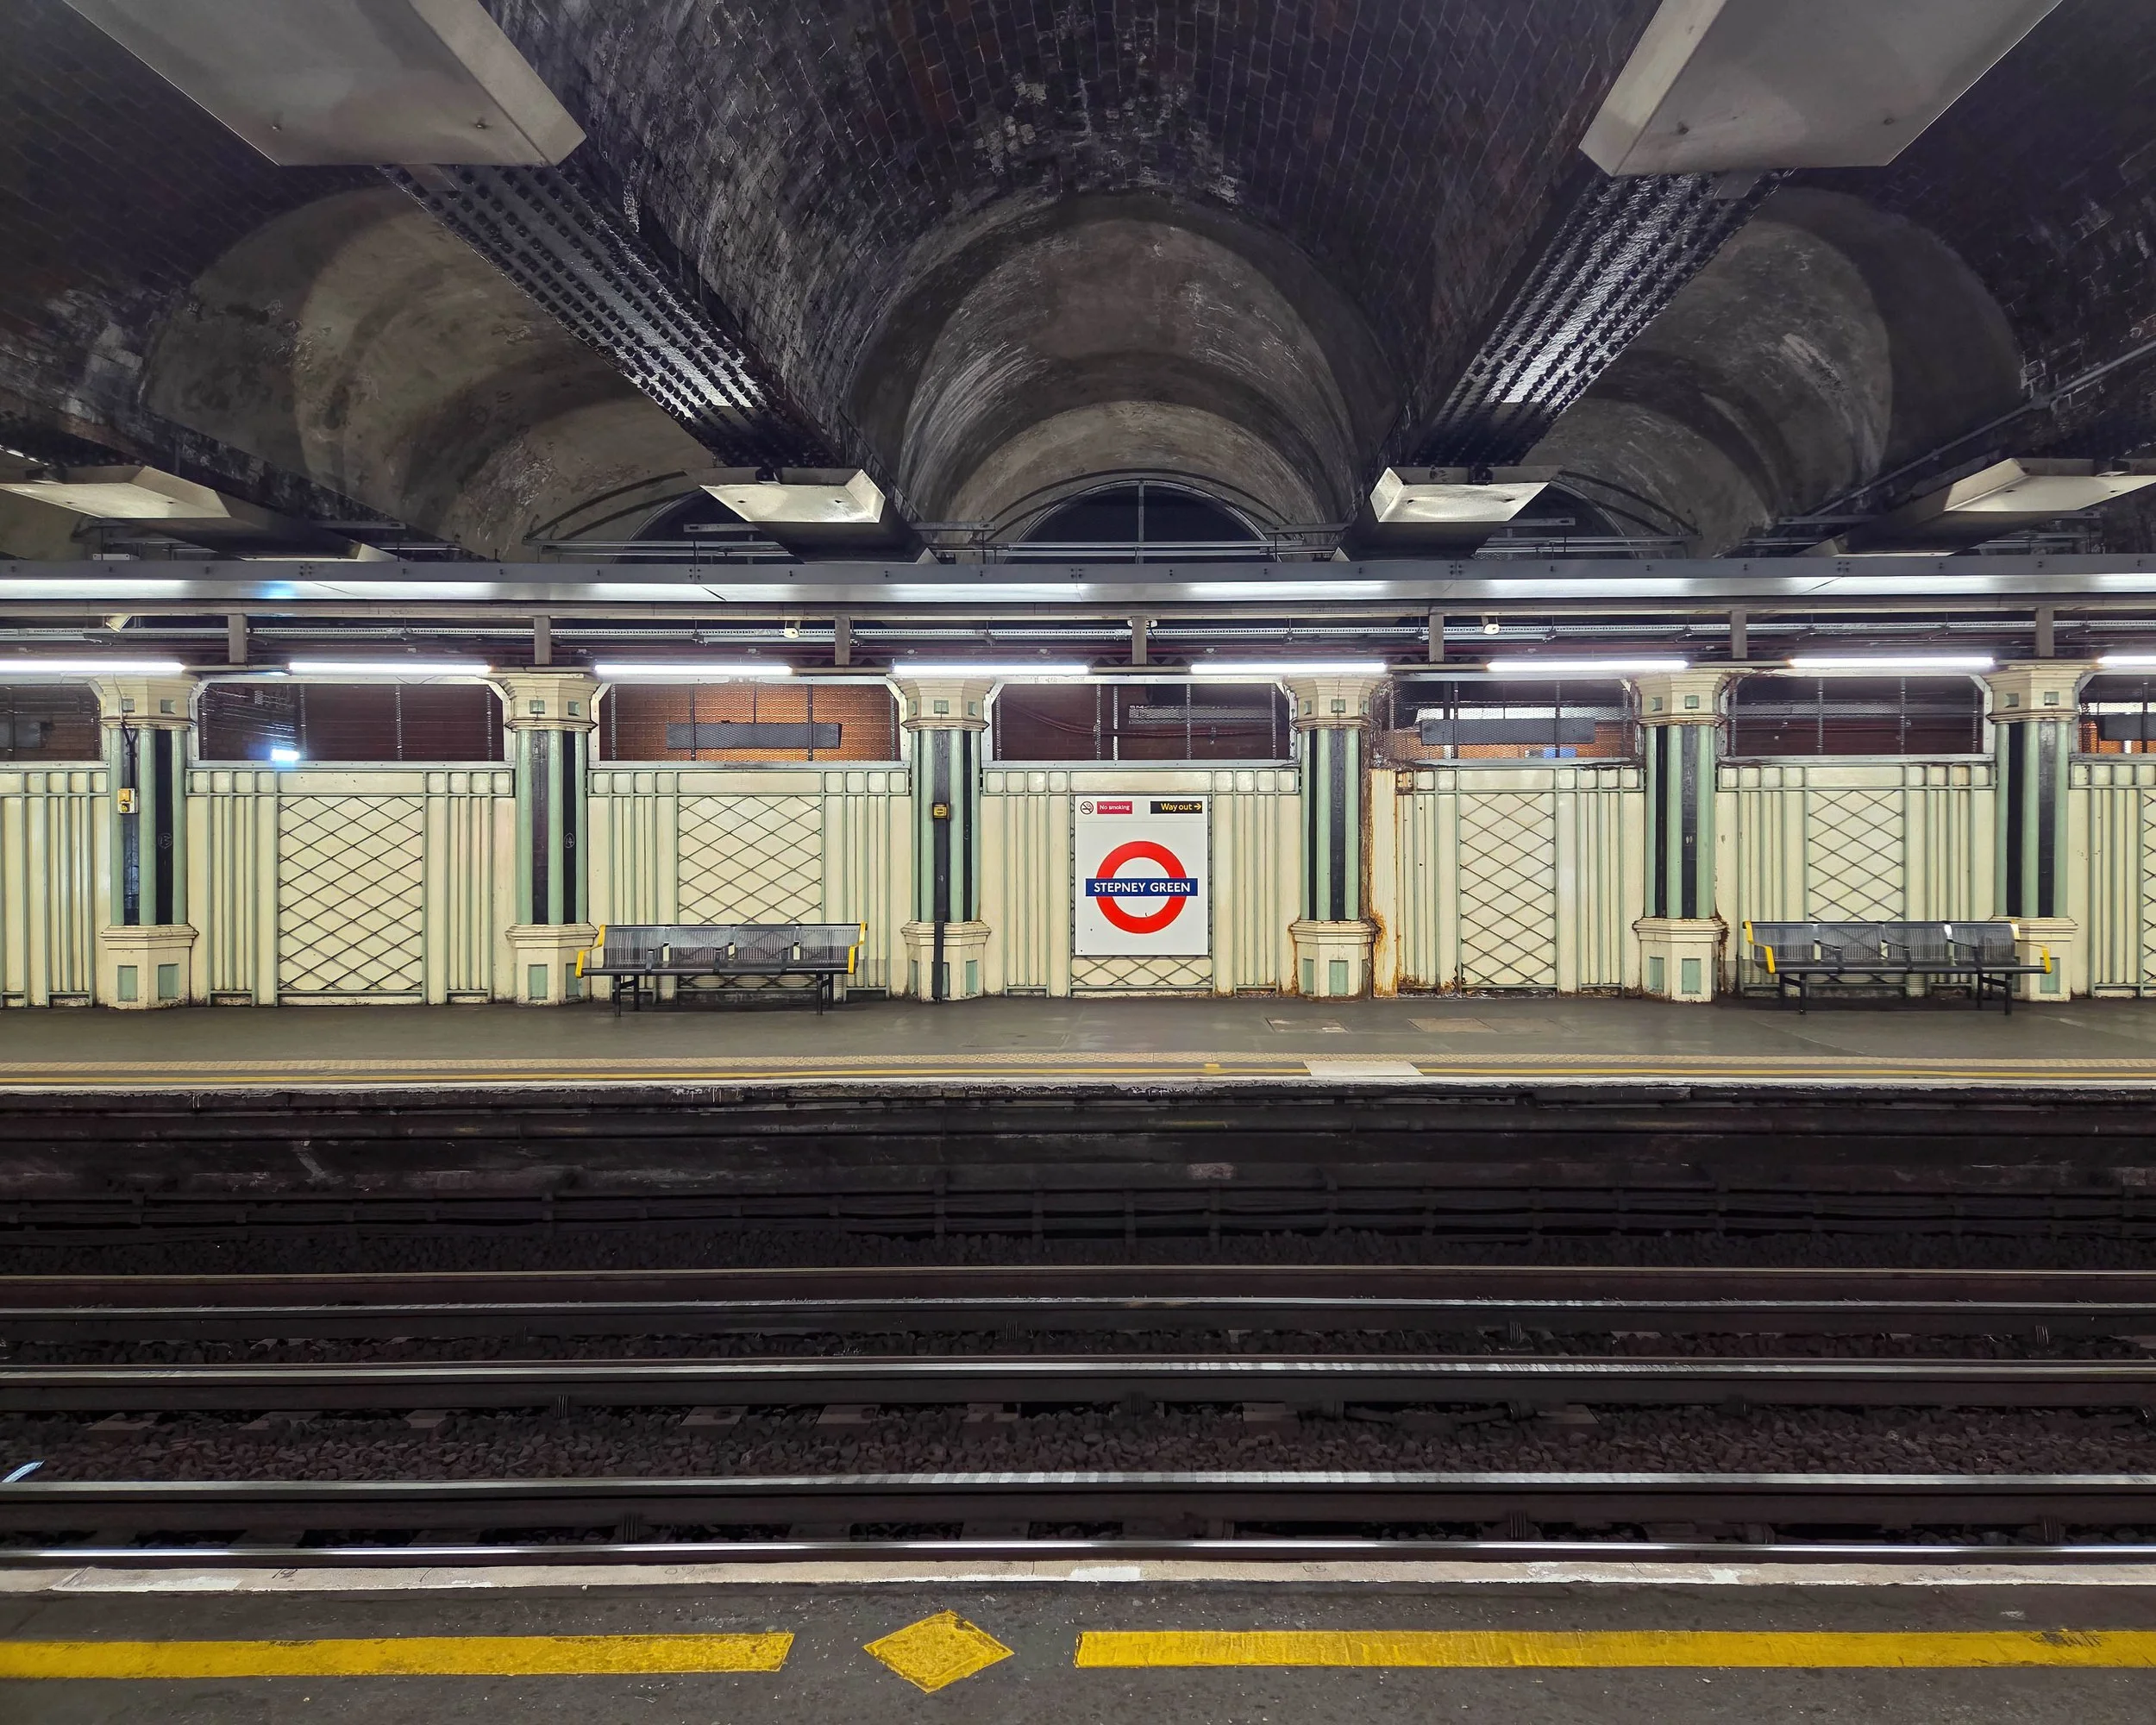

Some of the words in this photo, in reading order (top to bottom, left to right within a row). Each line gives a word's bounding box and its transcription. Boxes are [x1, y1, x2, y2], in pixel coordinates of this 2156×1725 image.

[1161, 803, 1178, 812] Way
[1094, 882, 1146, 893] STEPNEY
[1150, 882, 1190, 893] GREEN
